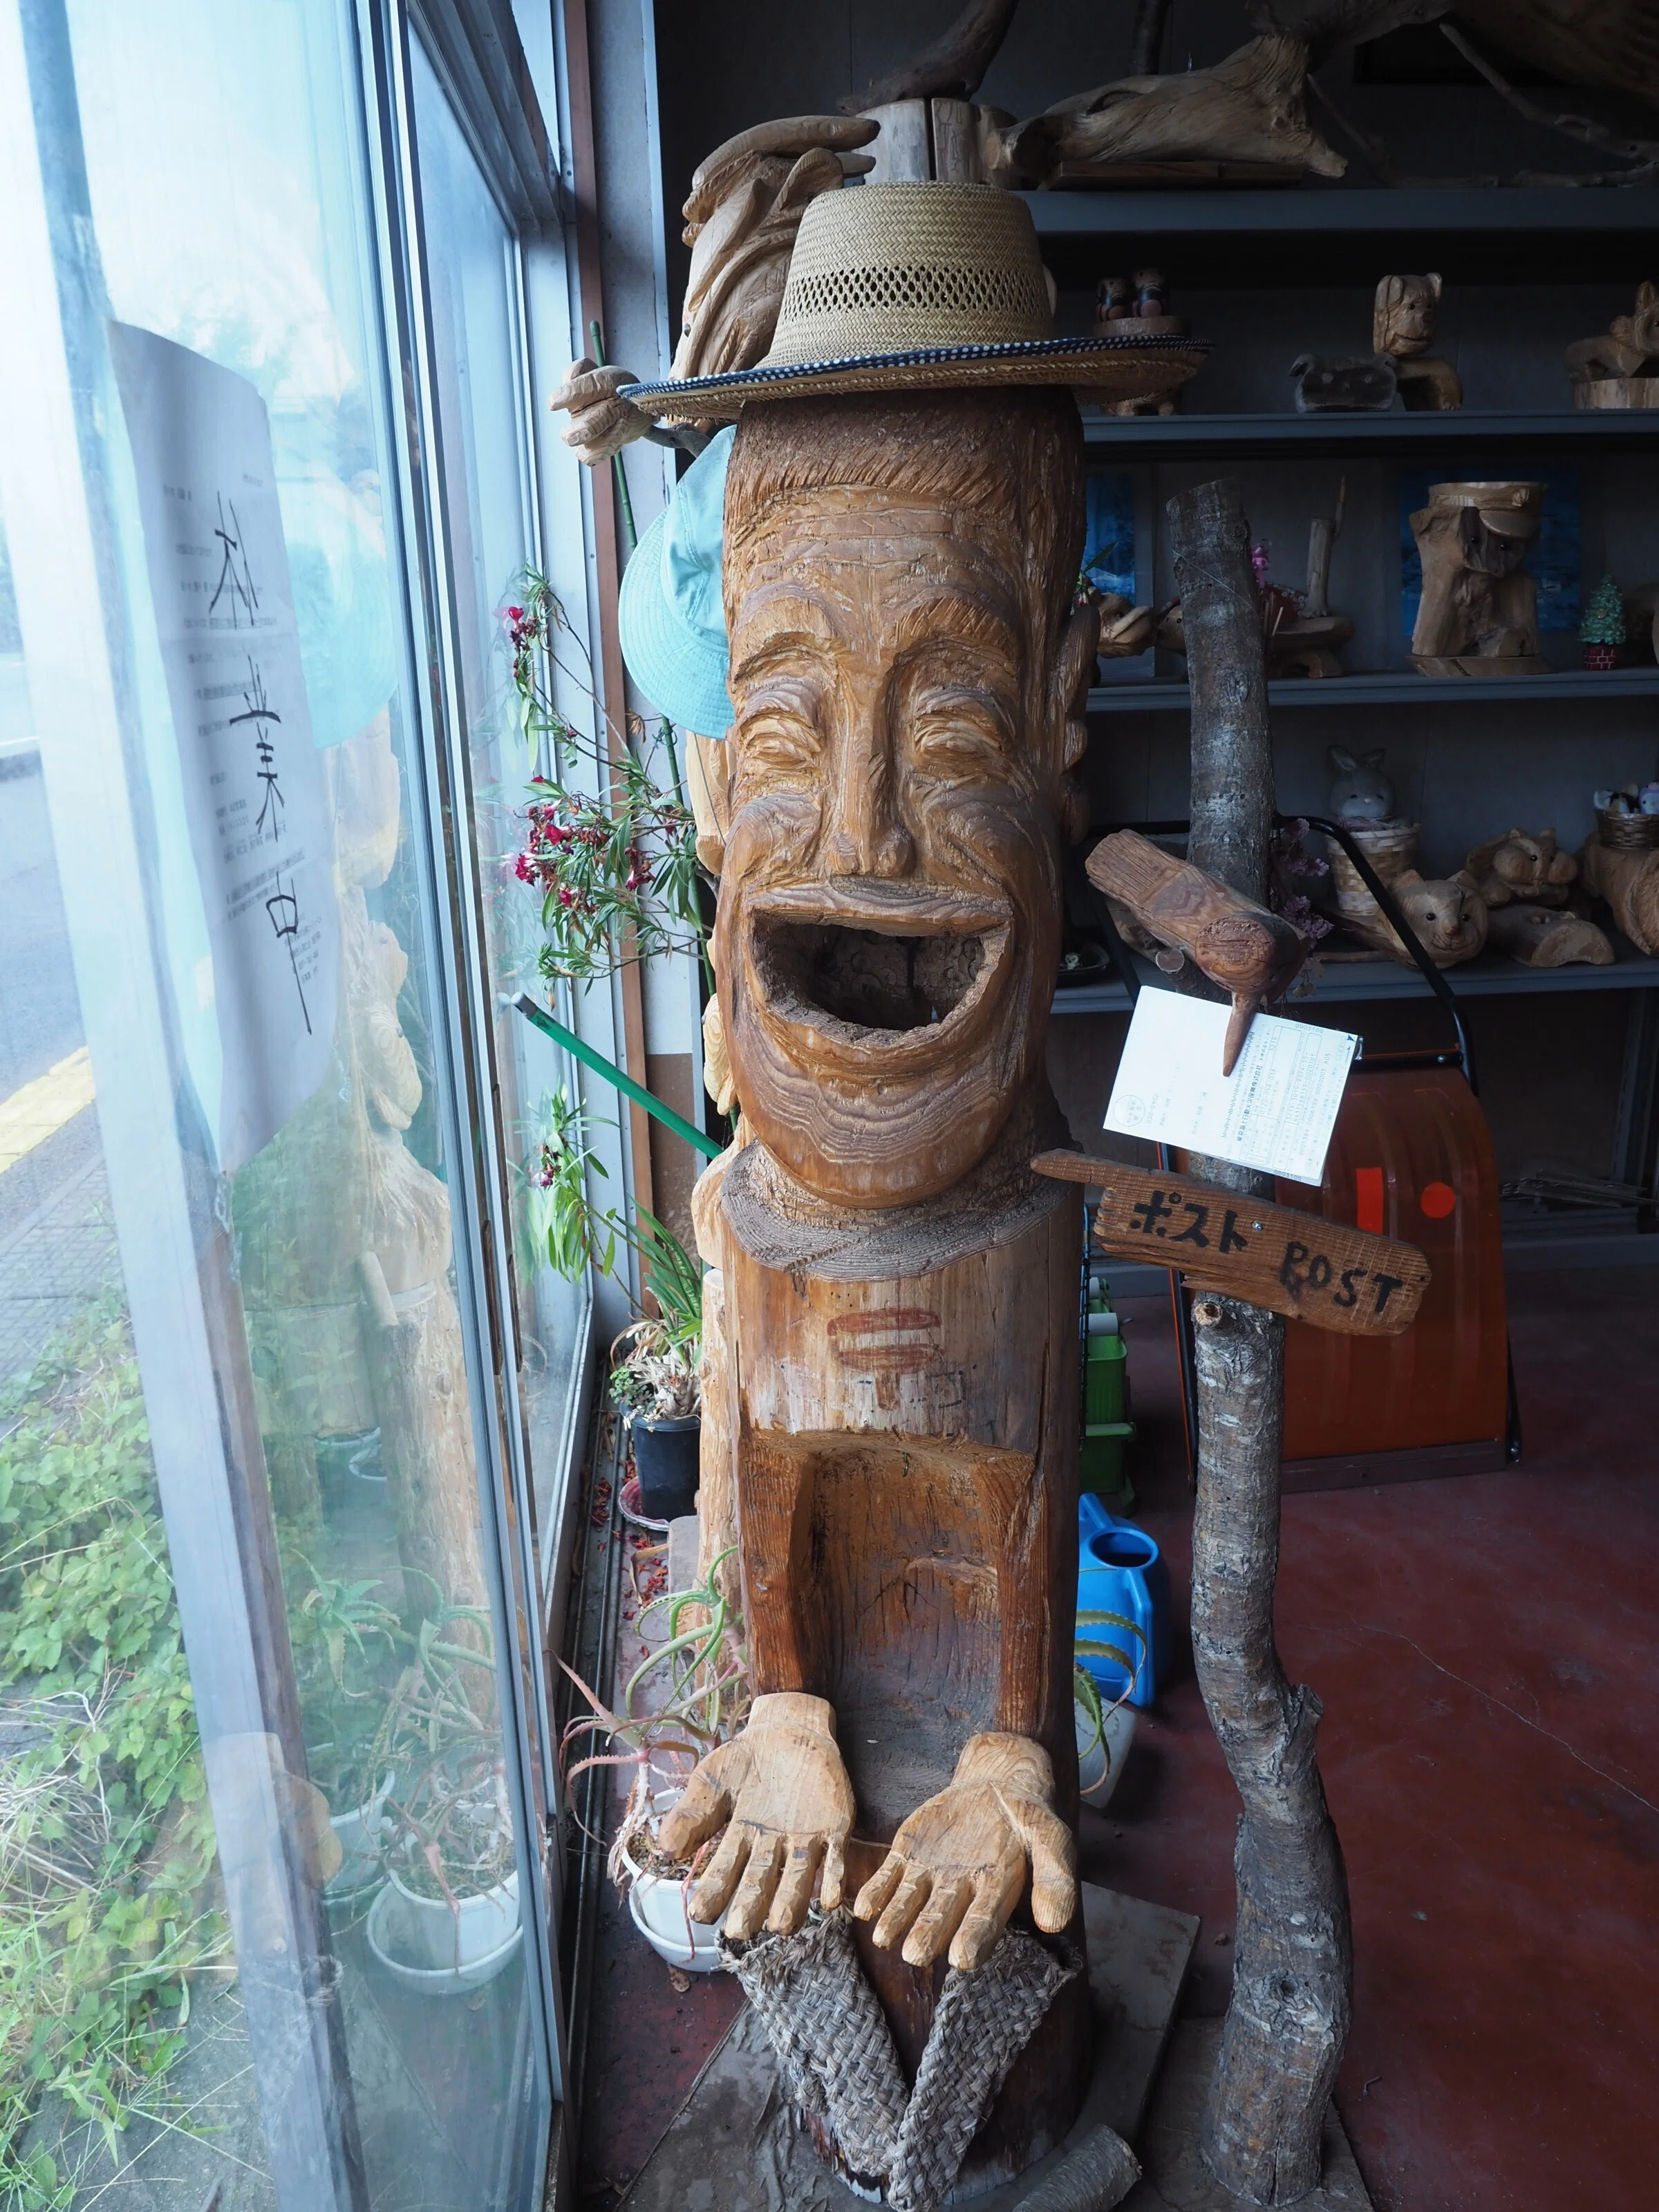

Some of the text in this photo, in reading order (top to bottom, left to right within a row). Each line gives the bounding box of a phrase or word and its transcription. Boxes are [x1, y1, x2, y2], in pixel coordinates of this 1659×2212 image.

[1295, 1022, 1324, 1034] 0003100
[1274, 1168, 1302, 1181] 0003100
[1130, 1190, 1404, 1314] ポスト POST
